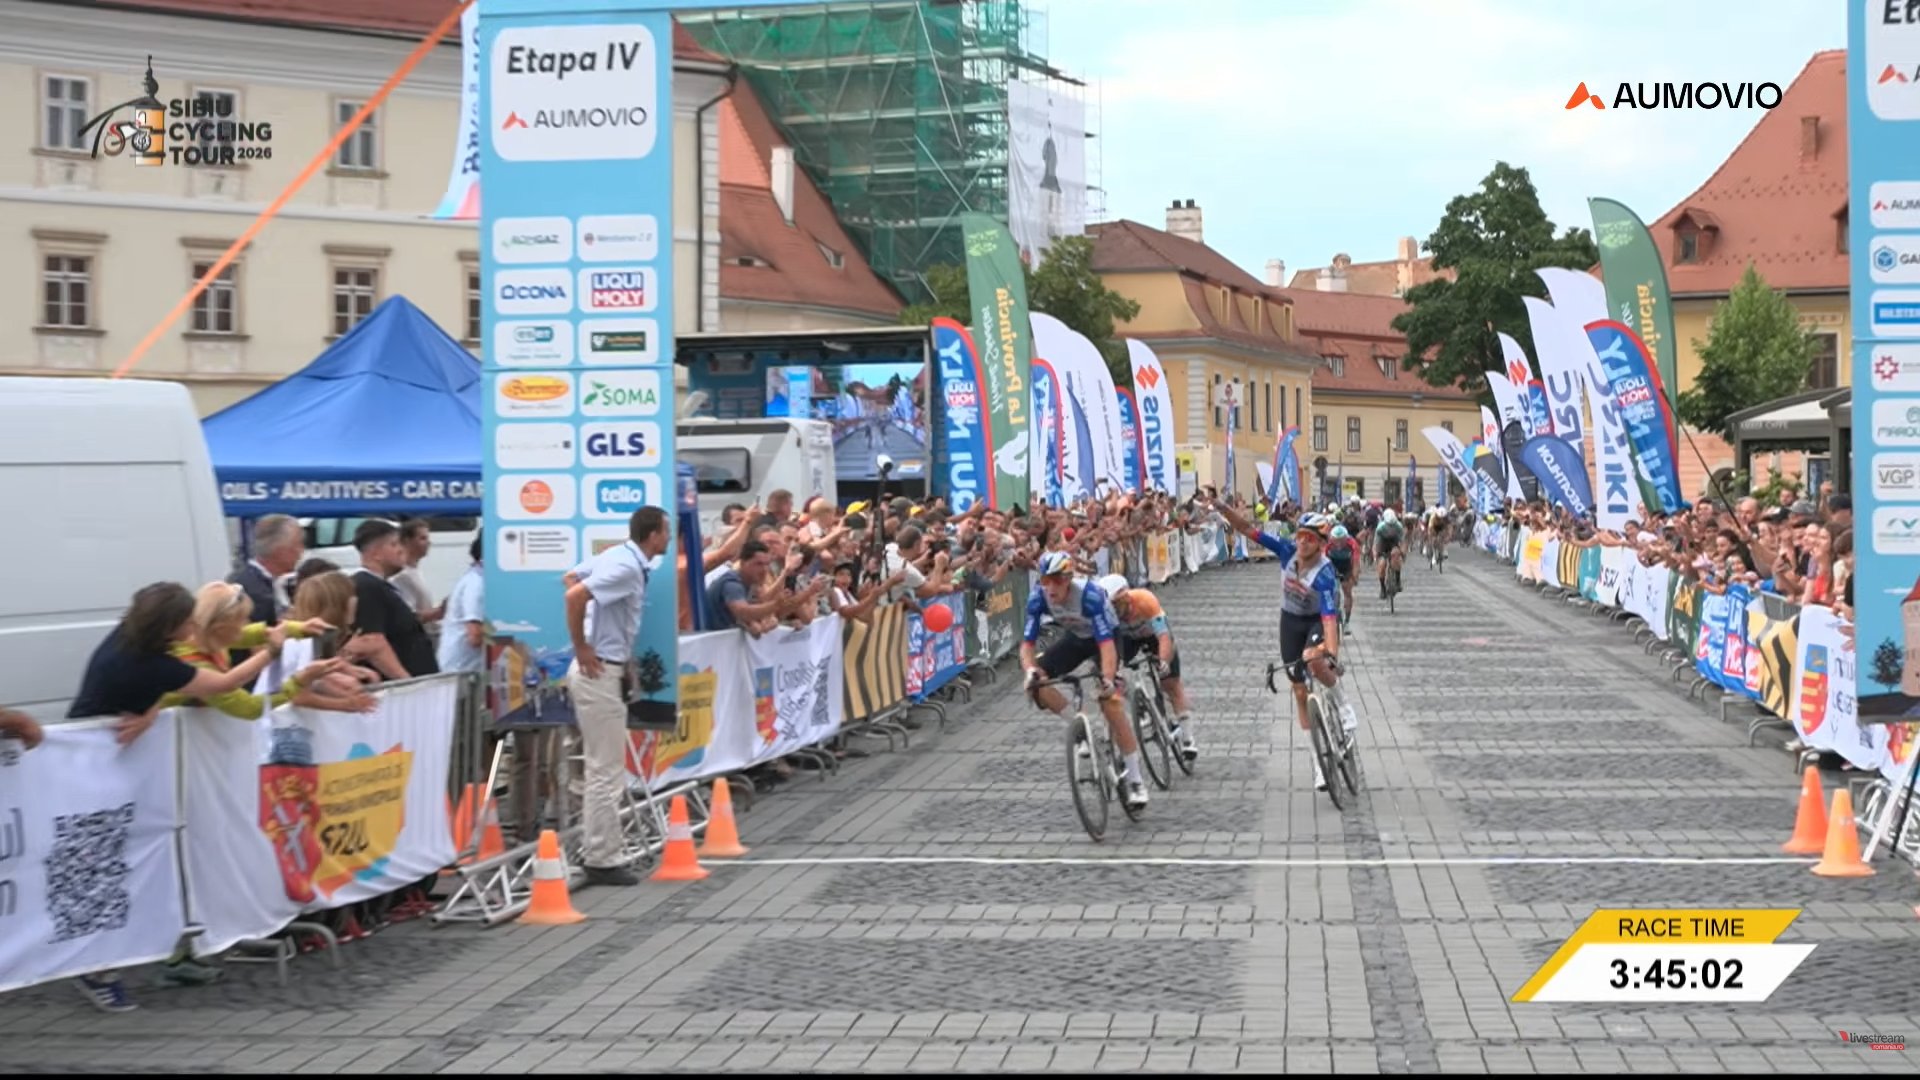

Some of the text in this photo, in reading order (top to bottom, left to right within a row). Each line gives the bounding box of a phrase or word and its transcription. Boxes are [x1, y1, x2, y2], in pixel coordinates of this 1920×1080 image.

[507, 42, 641, 80] Etapa IV
[534, 106, 648, 129] AUMOVIO
[593, 274, 642, 290] LIQUI
[593, 290, 643, 306] MOLY
[602, 388, 657, 406] SOMA
[1878, 469, 1914, 485] VGP
[223, 482, 268, 500] OILS
[280, 480, 390, 499] ADDITIVES
[402, 480, 446, 498] CAR
[600, 486, 643, 504] tello
